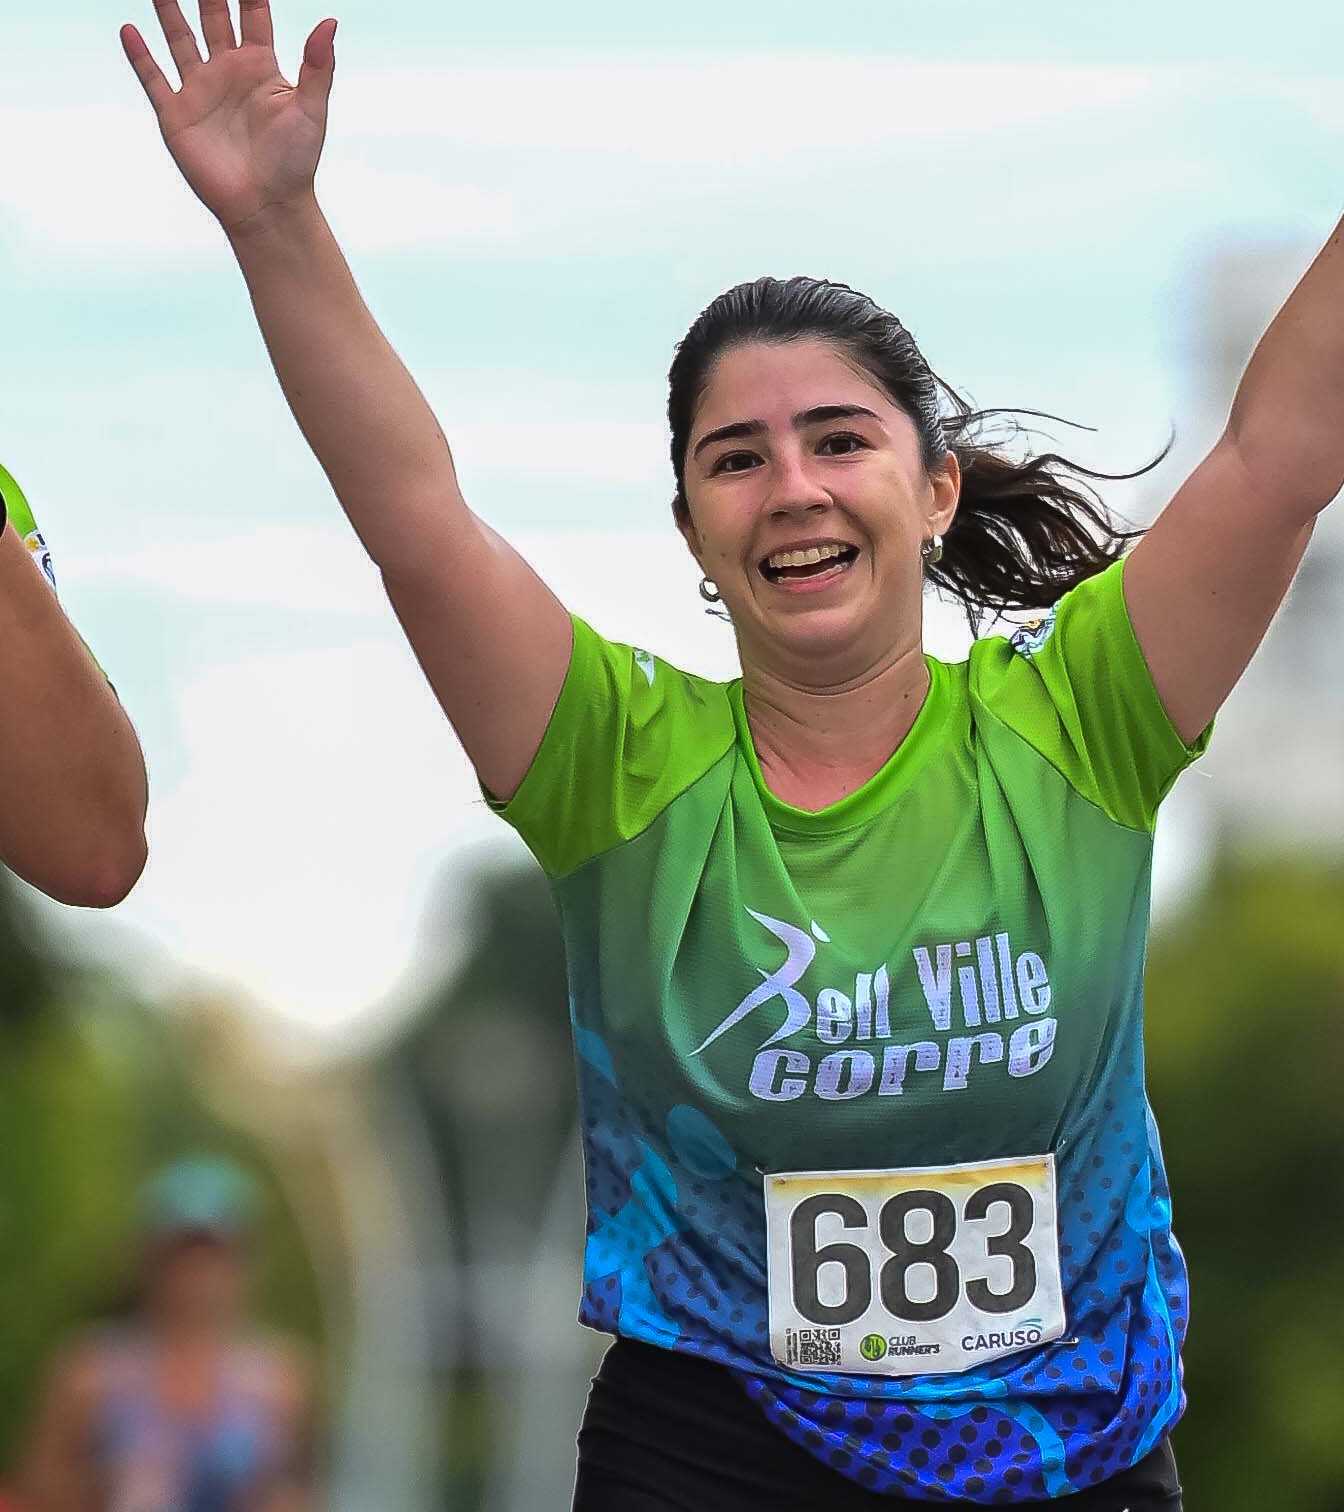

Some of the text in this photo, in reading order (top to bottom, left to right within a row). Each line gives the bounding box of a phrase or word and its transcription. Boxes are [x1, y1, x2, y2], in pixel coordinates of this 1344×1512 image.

[913, 932, 1053, 1030] Ville
[789, 1182, 1037, 1325] 683
[961, 1329, 1041, 1351] CARUSO
